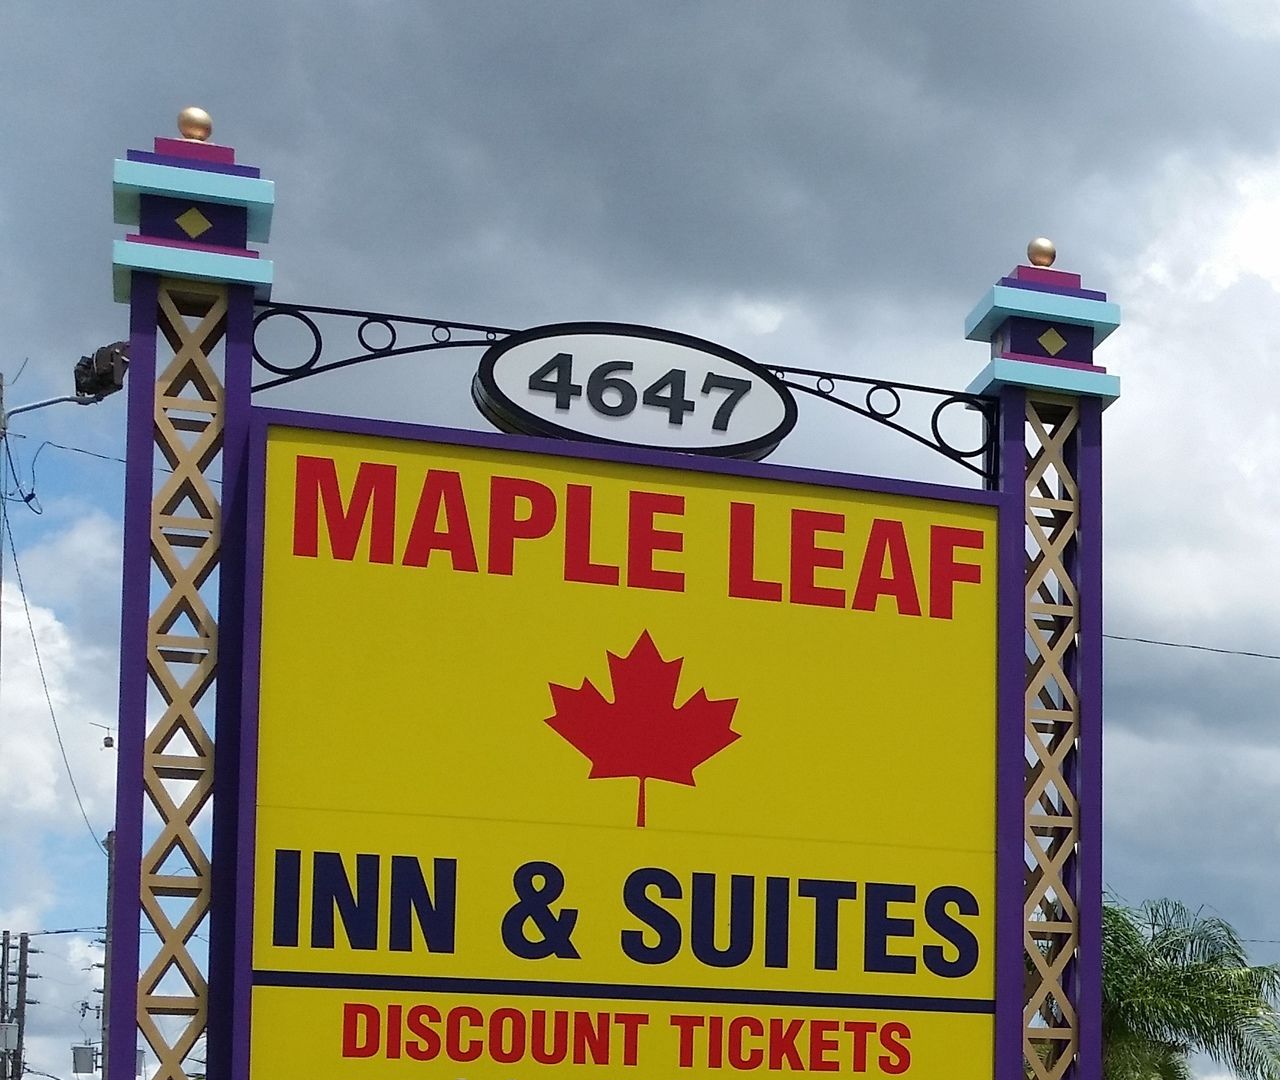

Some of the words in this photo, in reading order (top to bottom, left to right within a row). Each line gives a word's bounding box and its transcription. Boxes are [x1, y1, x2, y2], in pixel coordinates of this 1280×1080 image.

[528, 352, 753, 432] 4647
[292, 455, 686, 593] MAPLE
[728, 501, 985, 620] LEAF
[272, 848, 458, 954] INN
[500, 861, 582, 960] &
[620, 867, 980, 979] SUITES
[342, 1002, 649, 1066] DISCOUNT
[670, 1014, 912, 1075] TICKETS
